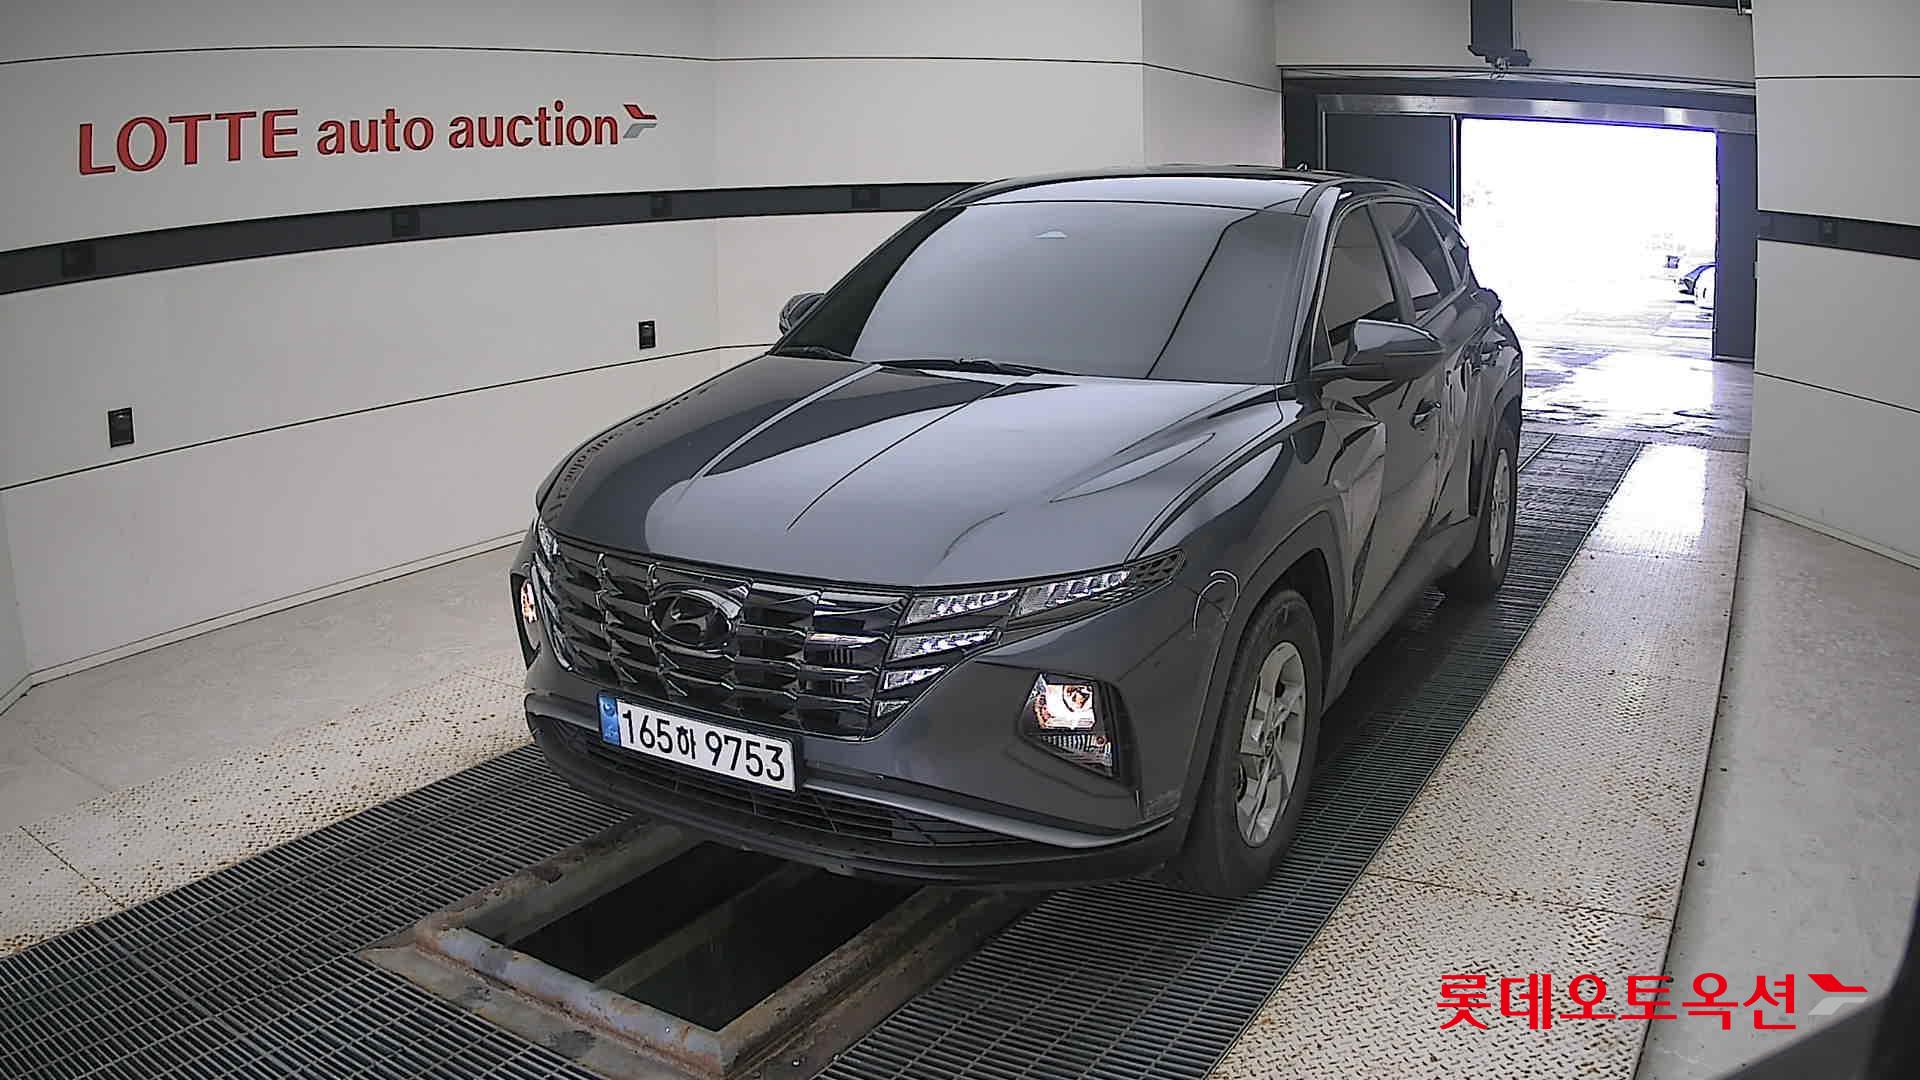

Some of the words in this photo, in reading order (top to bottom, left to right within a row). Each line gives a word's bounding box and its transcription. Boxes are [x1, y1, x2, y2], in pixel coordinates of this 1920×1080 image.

[79, 109, 298, 175] LOTTE
[316, 109, 435, 155] auto
[449, 101, 619, 148] auction
[622, 710, 696, 760] 165하
[705, 730, 785, 781] 9753
